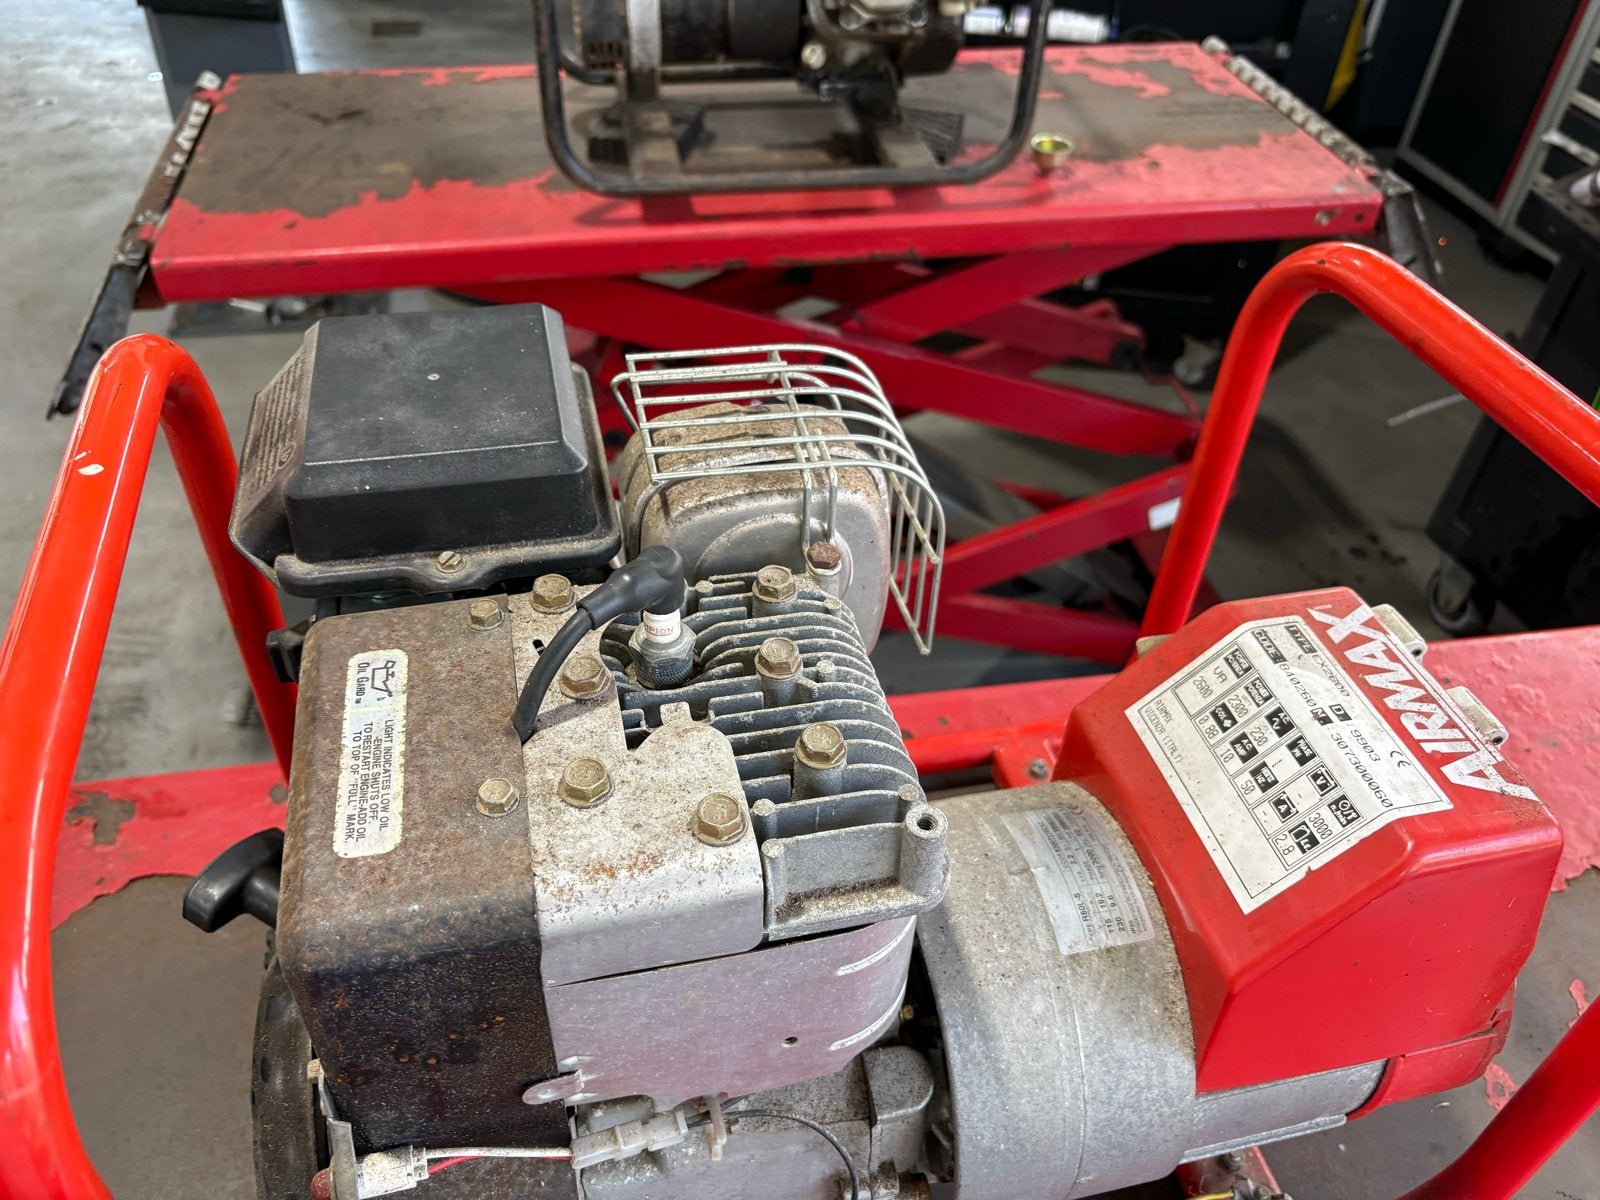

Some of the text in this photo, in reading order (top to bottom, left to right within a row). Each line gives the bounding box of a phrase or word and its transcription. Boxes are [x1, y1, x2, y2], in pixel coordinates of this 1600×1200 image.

[1226, 654, 1244, 676] POTENZA
[1234, 651, 1248, 669] POWER
[1289, 626, 1350, 696] TYPE EX2600
[1212, 666, 1228, 684] VA
[1280, 665, 1316, 707] 840260
[1192, 675, 1213, 699] 2600
[1246, 683, 1264, 706] POTENZA
[1253, 680, 1269, 698] POWER
[1154, 699, 1173, 724] AIRMAX
[1228, 694, 1248, 718] 2300
[1306, 604, 1540, 801] AIRMAX
[352, 731, 362, 742] TO
[1144, 706, 1183, 763] VICENZA (ITALY)
[1198, 715, 1219, 739] 0.88
[1250, 727, 1268, 747] 230
[351, 744, 361, 761] TOP
[1220, 749, 1235, 762] 10
[1233, 743, 1246, 757] AMP
[1292, 749, 1301, 757] PH
[1297, 739, 1312, 757] PHASE
[350, 764, 359, 775] OF
[379, 720, 394, 831] LIGHT INDICATES LOW OIL
[1261, 767, 1274, 783] HERTZ
[1331, 733, 1393, 808] 307300060
[356, 722, 373, 842] TO RESTART ENGINE-ADD OIL
[370, 772, 380, 800] SHUTS
[1240, 780, 1256, 795] 50
[368, 803, 379, 824] OFF.
[345, 814, 356, 843] MARK.
[1308, 812, 1333, 840] 3000
[1275, 833, 1295, 856] 2.8
[1105, 918, 1114, 934] 115
[1115, 917, 1125, 932] 230
